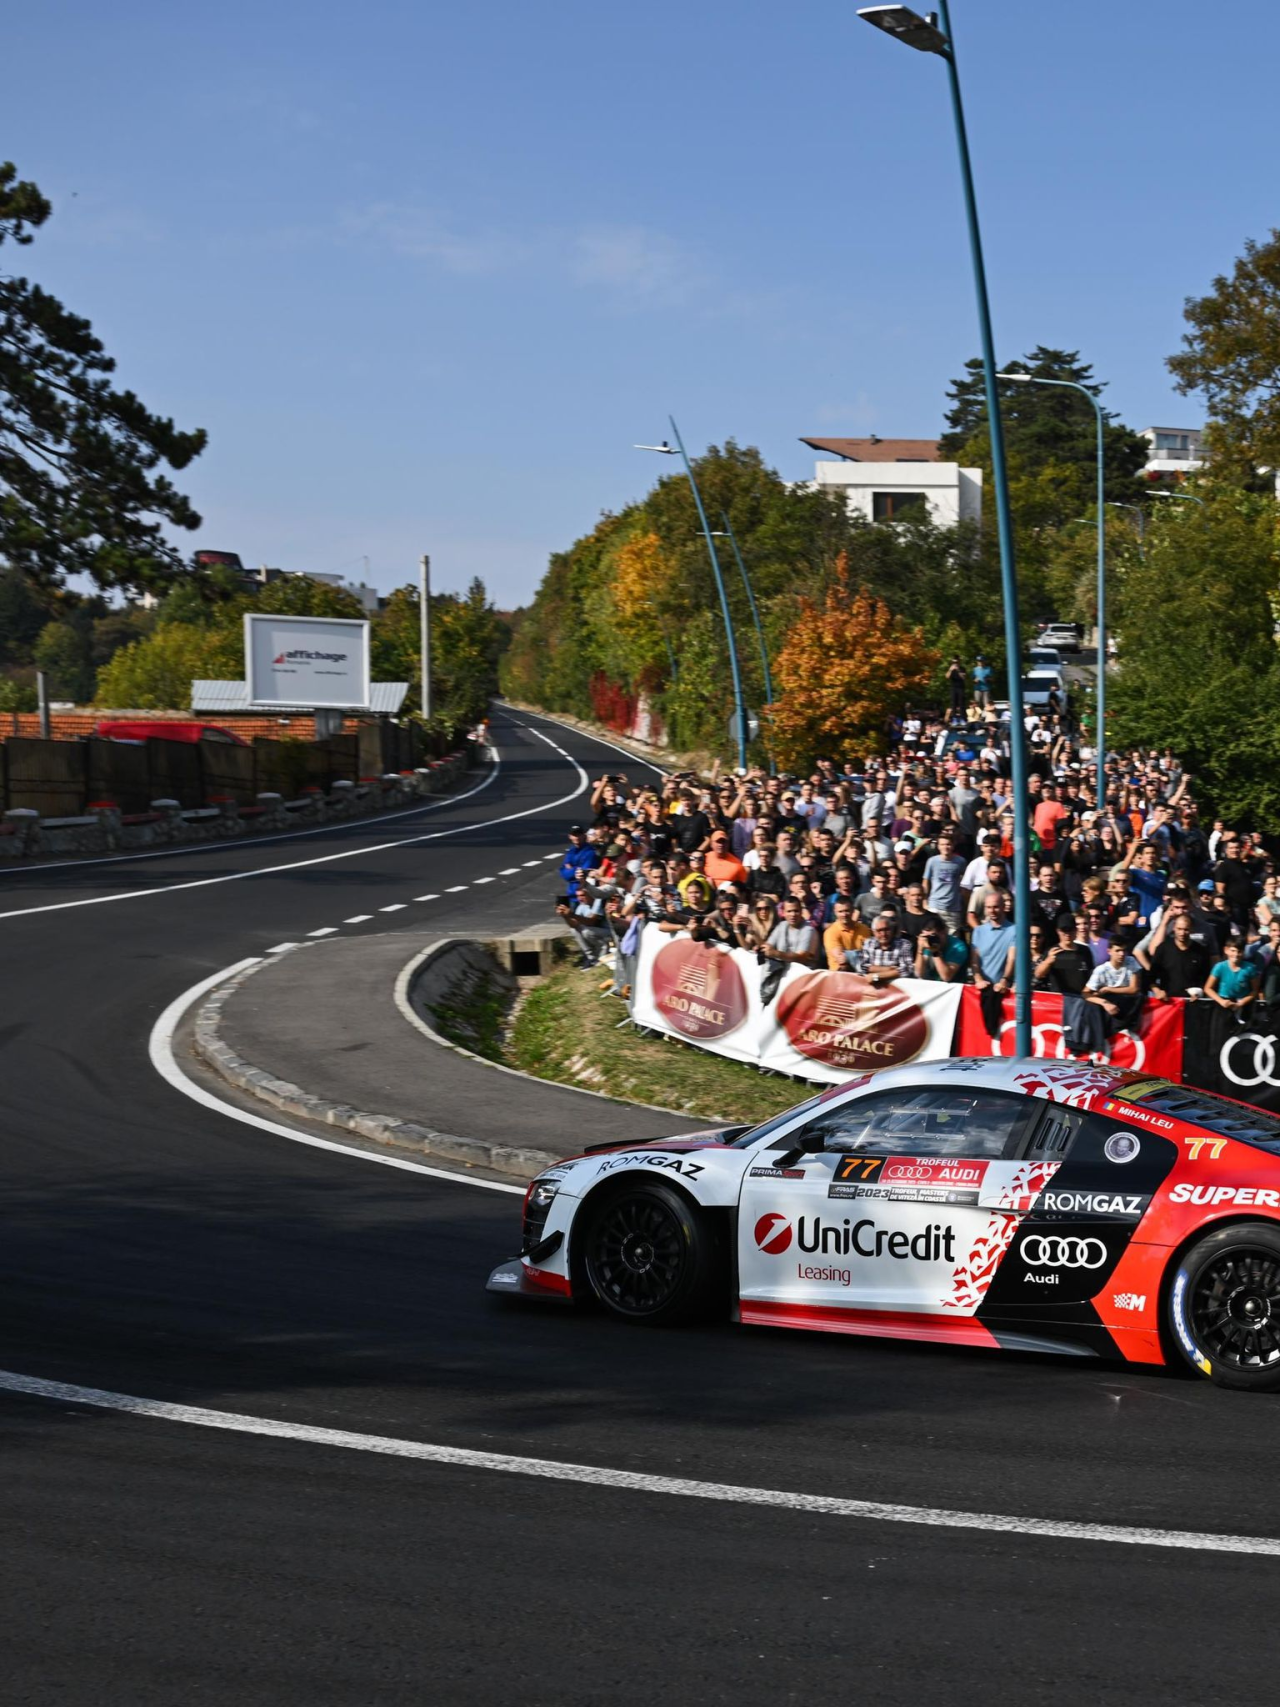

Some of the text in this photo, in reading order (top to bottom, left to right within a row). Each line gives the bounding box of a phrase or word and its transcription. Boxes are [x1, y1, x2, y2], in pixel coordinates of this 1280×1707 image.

[286, 650, 348, 662] affichage
[833, 1034, 894, 1057] PALACE
[1118, 1107, 1174, 1129] MIHAI LEU
[1184, 1137, 1228, 1160] 77
[596, 1155, 705, 1182] ROMGAZ
[751, 1168, 783, 1176] PRIMA
[842, 1158, 882, 1179] 77
[916, 1158, 959, 1167] TROFEUL
[938, 1168, 980, 1181] AUDI
[856, 1188, 890, 1198] 2023
[1044, 1193, 1142, 1214] ROMGAZ
[798, 1216, 955, 1262] UniCredit
[798, 1263, 851, 1286] Leasing
[1024, 1272, 1059, 1284] Audi
